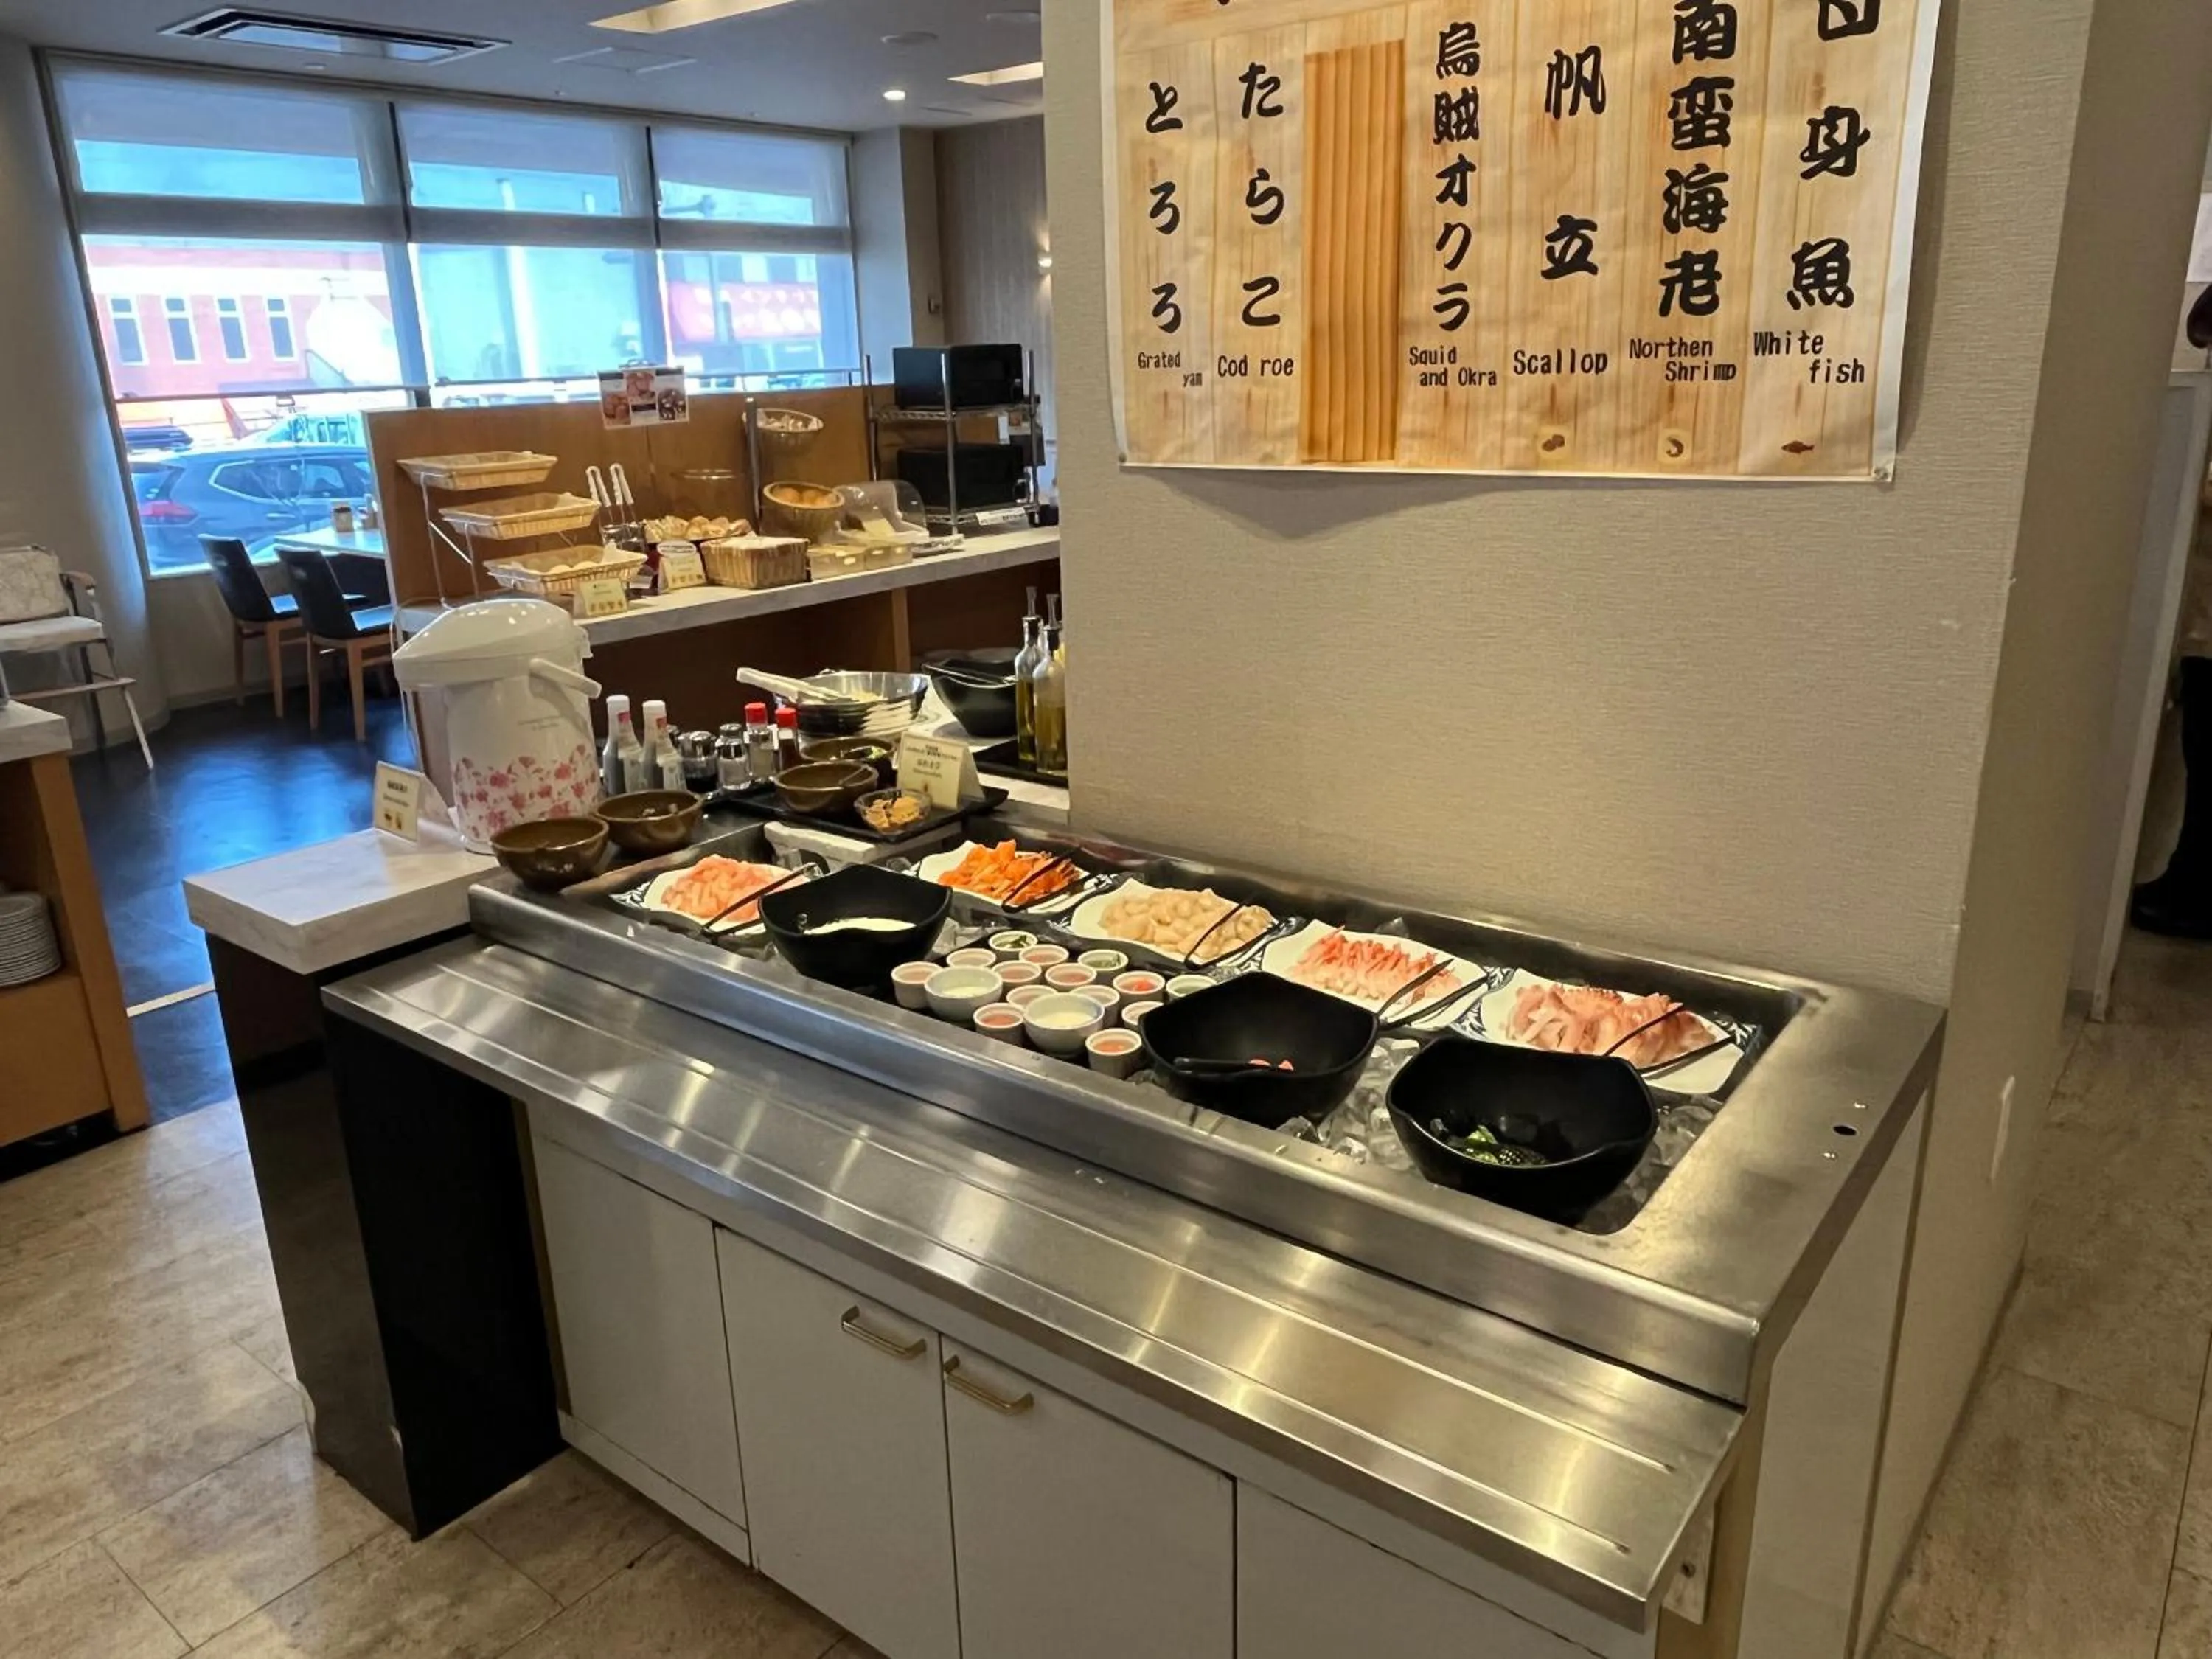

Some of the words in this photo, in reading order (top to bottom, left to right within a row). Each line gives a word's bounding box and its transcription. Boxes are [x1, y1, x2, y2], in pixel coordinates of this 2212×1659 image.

[1540, 46, 1606, 279] 帆立
[1658, 0, 1737, 317] 南蛮海老
[1238, 63, 1284, 327] たらこ
[1146, 82, 1183, 333] とろろ
[1630, 336, 1713, 359] Northen
[1753, 330, 1823, 356] White
[1138, 352, 1180, 369] Grated
[1217, 355, 1248, 378] Cod
[1260, 358, 1294, 376] roe
[1409, 346, 1457, 366] Squid
[1514, 349, 1608, 375] Scallop
[1183, 372, 1203, 387] yam
[1419, 367, 1448, 386] and
[1458, 367, 1497, 386] Okra
[1665, 361, 1736, 382] Shrimp
[1809, 358, 1865, 383] fish
